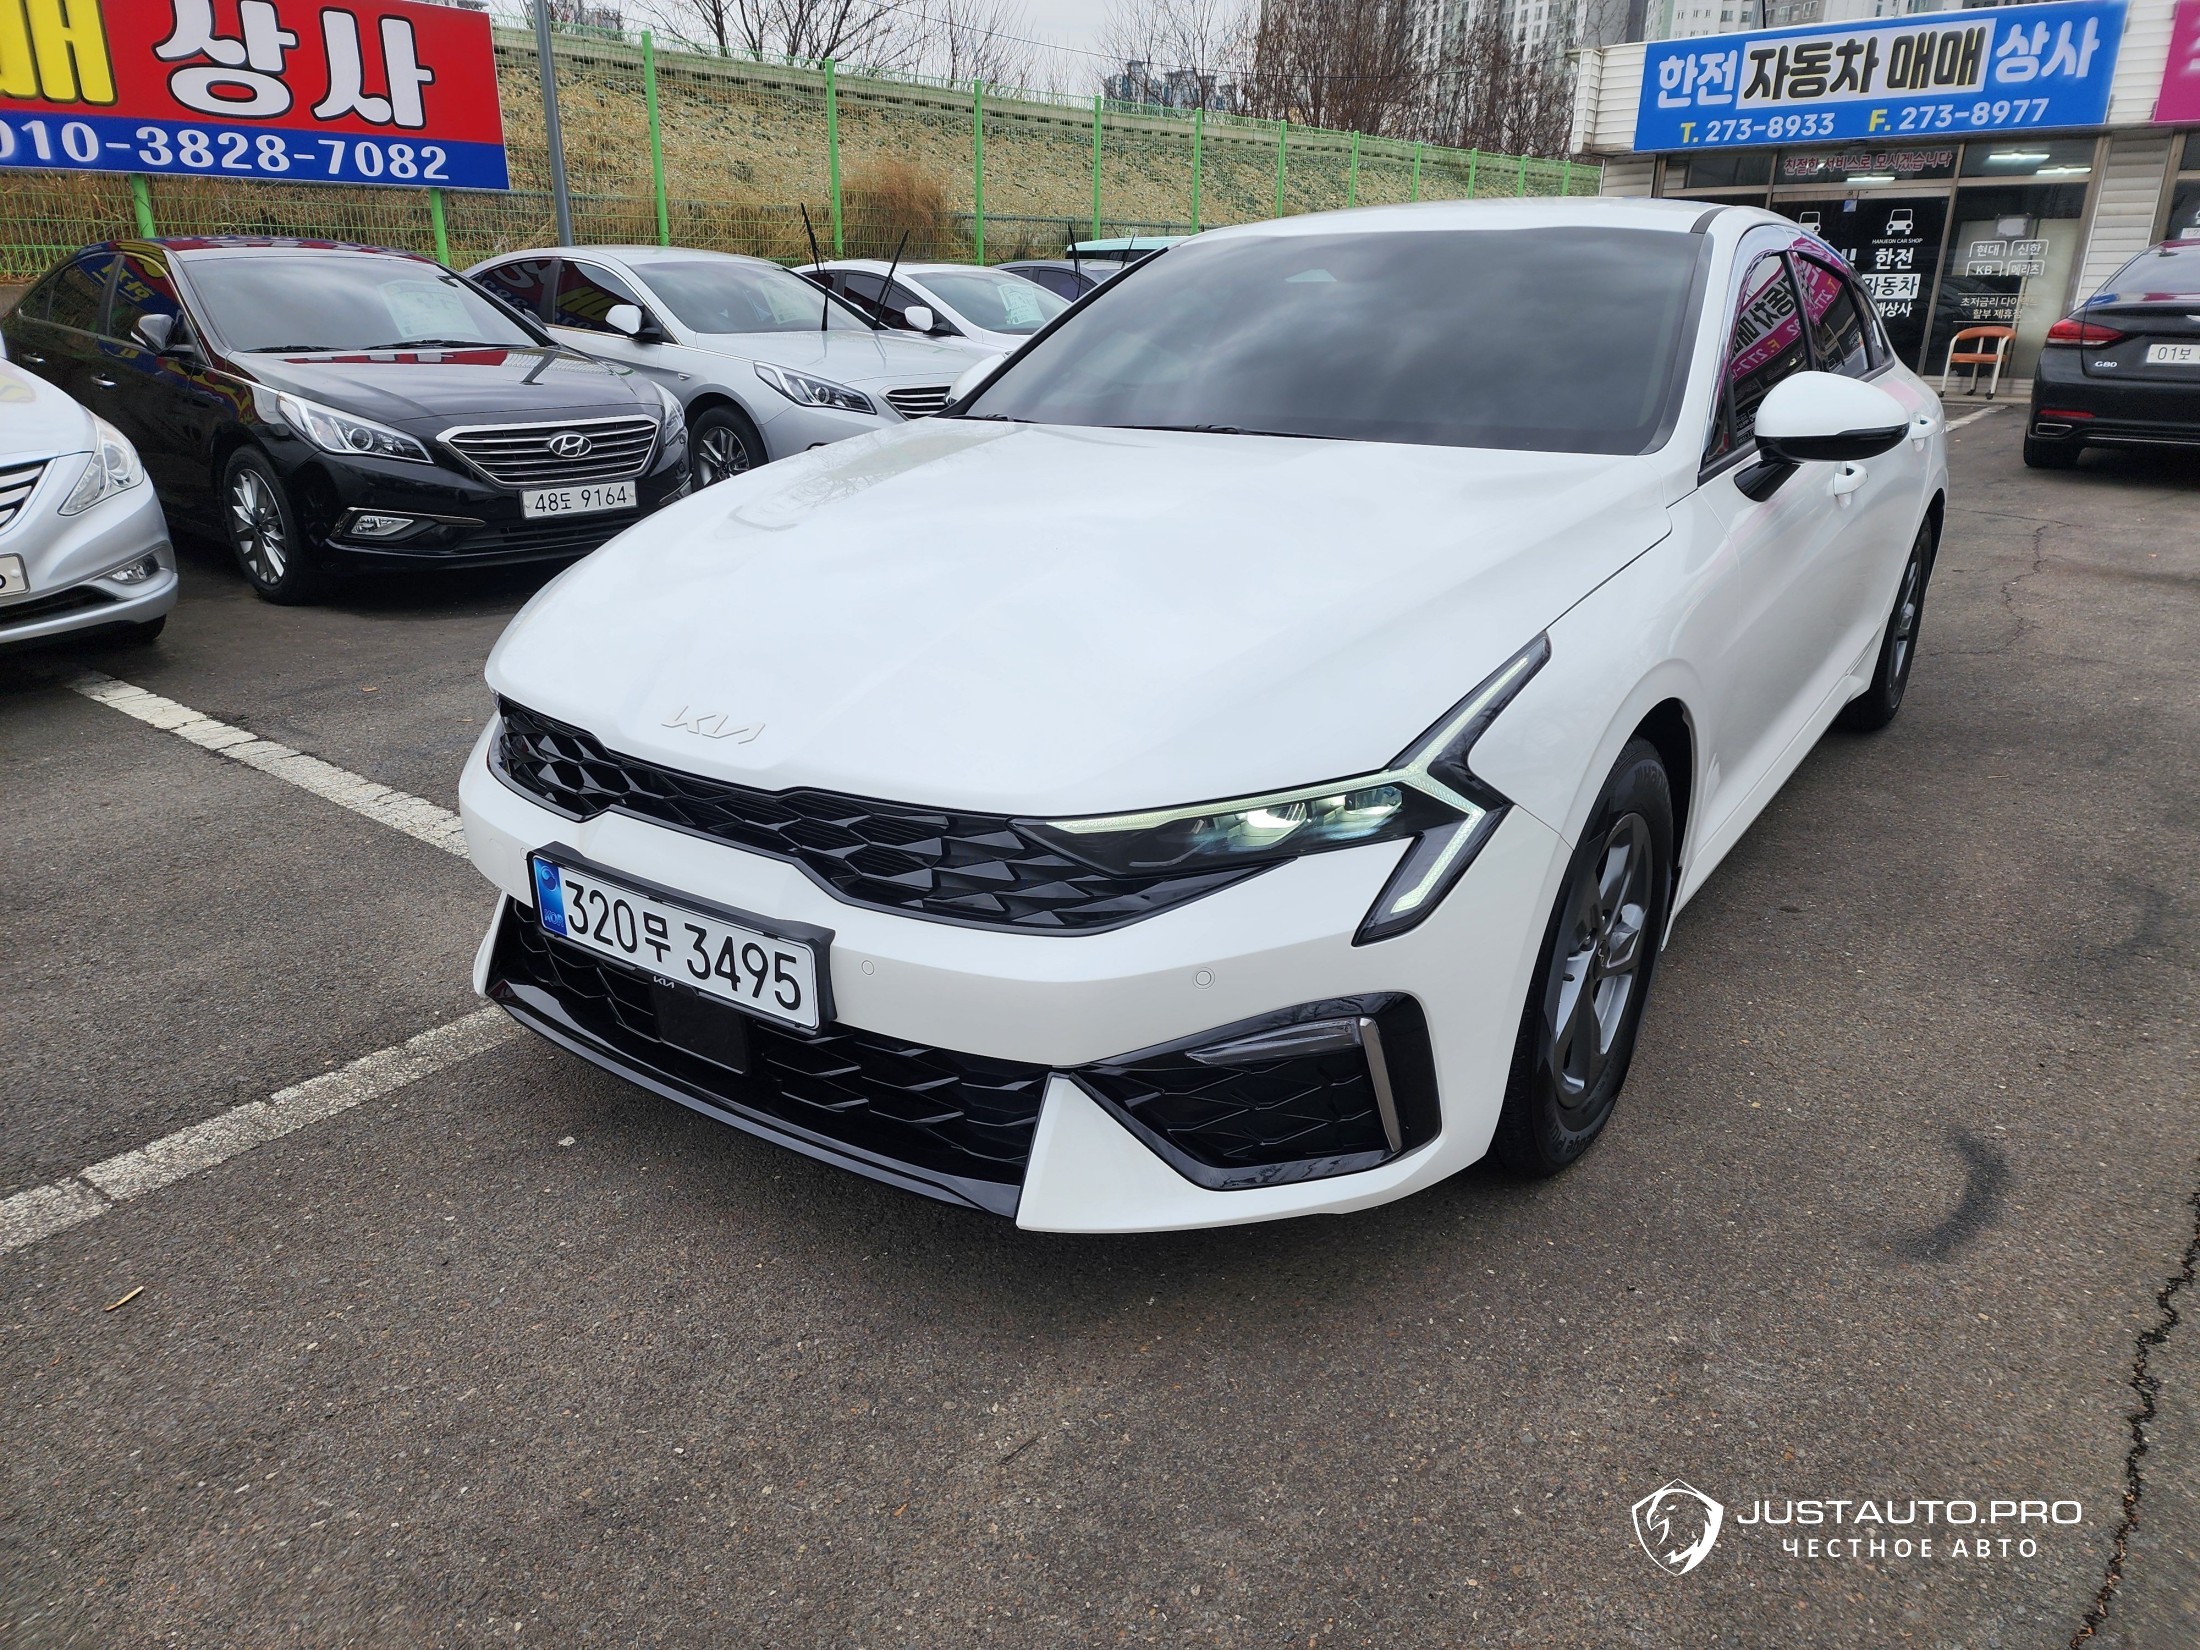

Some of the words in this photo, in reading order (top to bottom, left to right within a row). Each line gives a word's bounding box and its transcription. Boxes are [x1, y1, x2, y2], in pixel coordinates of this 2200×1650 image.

[154, 0, 435, 128] 상사
[1657, 49, 1738, 109] 한전
[1743, 36, 1880, 100] 자동차
[1886, 26, 1987, 90] 매매
[1995, 16, 2100, 83] 상사
[1680, 122, 1699, 143] T.
[1705, 112, 1836, 142] 273-8933
[1868, 109, 1892, 131] F.
[1898, 98, 2050, 130] 273-8977
[1784, 157, 1819, 176] 친절한
[1824, 154, 1874, 171] 서비스로
[1873, 151, 1952, 172] 모시겠습니다
[1977, 244, 2000, 257] 현대
[2018, 243, 2042, 256] 신한
[1875, 247, 1914, 270] 한전
[1976, 265, 1993, 275] KB
[2011, 263, 2040, 276] 메리츠
[1960, 297, 1999, 307] 초저금리
[1973, 308, 1992, 320] 할부
[2157, 346, 2192, 361] 01보
[2094, 360, 2118, 368] G80
[534, 492, 572, 513] 48도
[580, 485, 628, 508] 9164
[565, 879, 671, 963] 320무
[684, 922, 802, 1011] 3495
[653, 975, 675, 989] KIA
